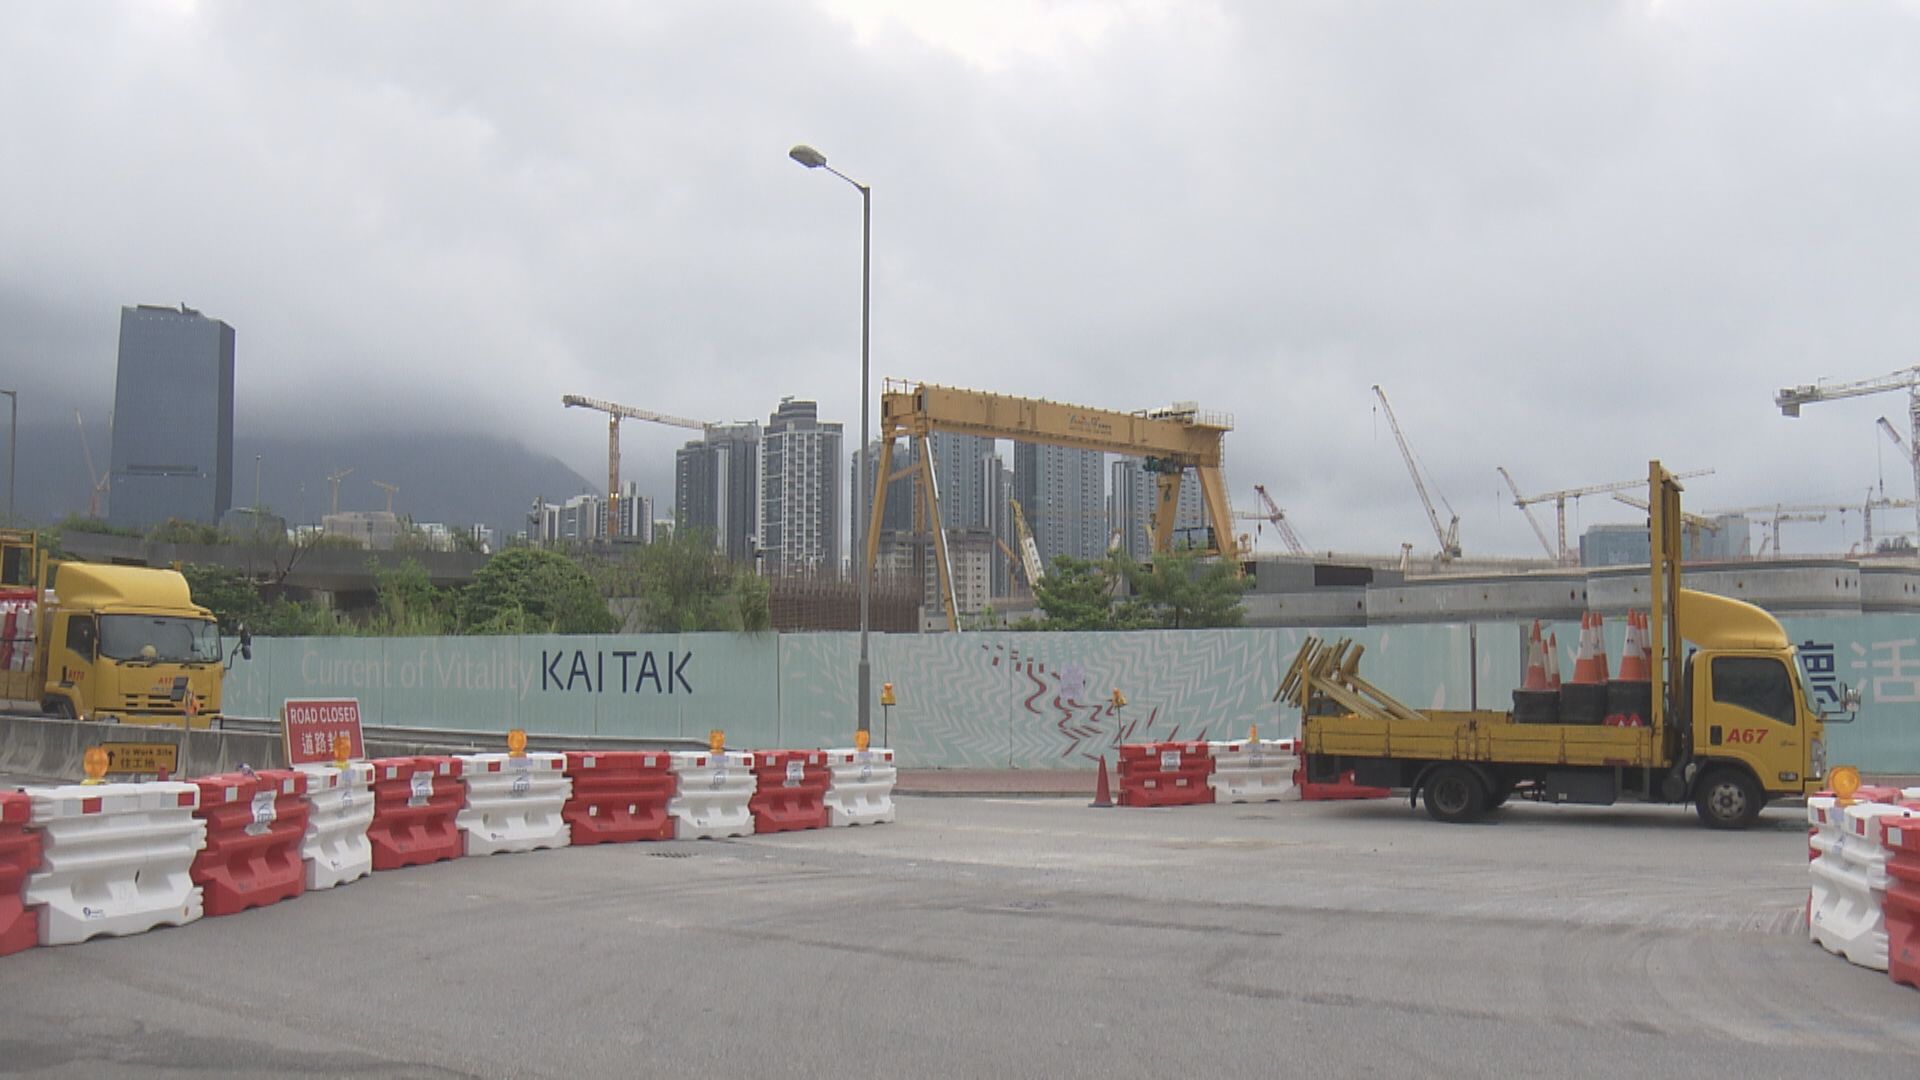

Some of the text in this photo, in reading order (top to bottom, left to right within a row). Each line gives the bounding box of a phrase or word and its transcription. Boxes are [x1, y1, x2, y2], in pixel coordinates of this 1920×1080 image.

[300, 650, 535, 699] Current of Vitality
[541, 650, 693, 694] KAI TAK
[290, 707, 357, 724] ROAD CLOSED
[1726, 728, 1769, 744] A67
[120, 747, 130, 756] To
[133, 747, 153, 756] Work
